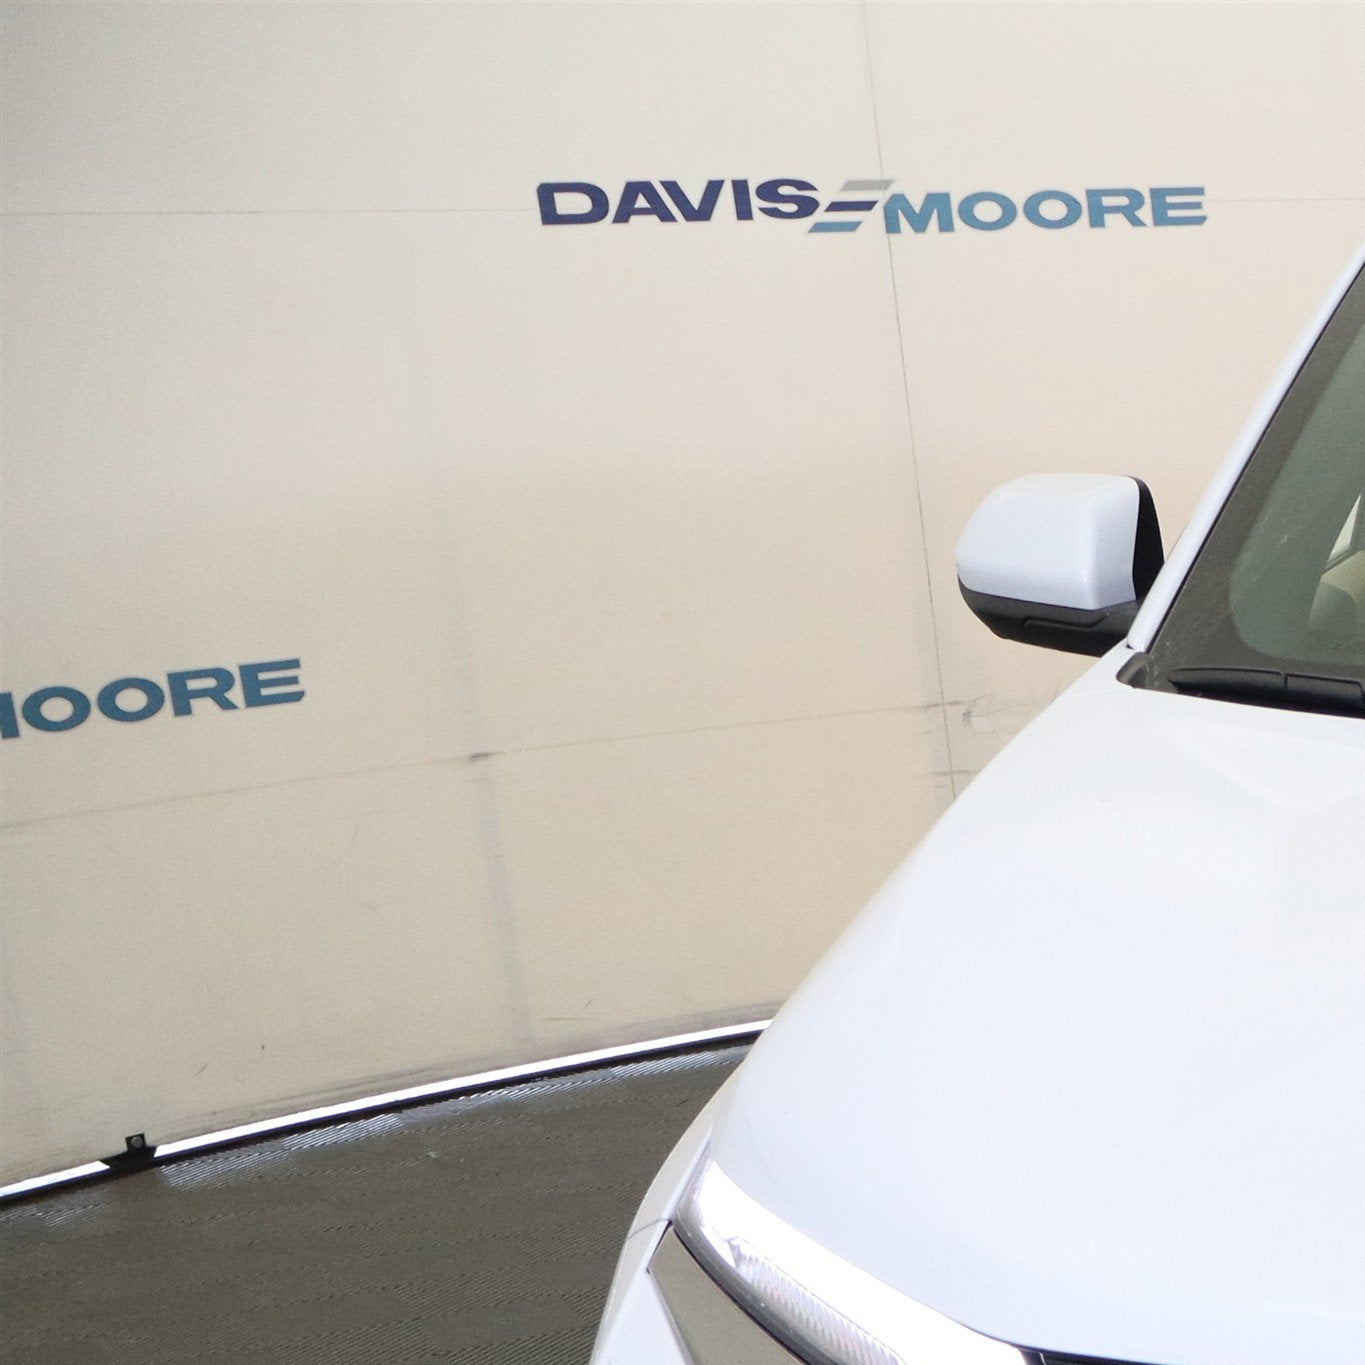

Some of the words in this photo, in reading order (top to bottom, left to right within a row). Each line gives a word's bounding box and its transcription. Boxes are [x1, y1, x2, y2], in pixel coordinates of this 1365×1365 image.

[536, 179, 821, 226] DAVIS
[881, 187, 1208, 234] MOORE
[0, 658, 305, 740] OORE
